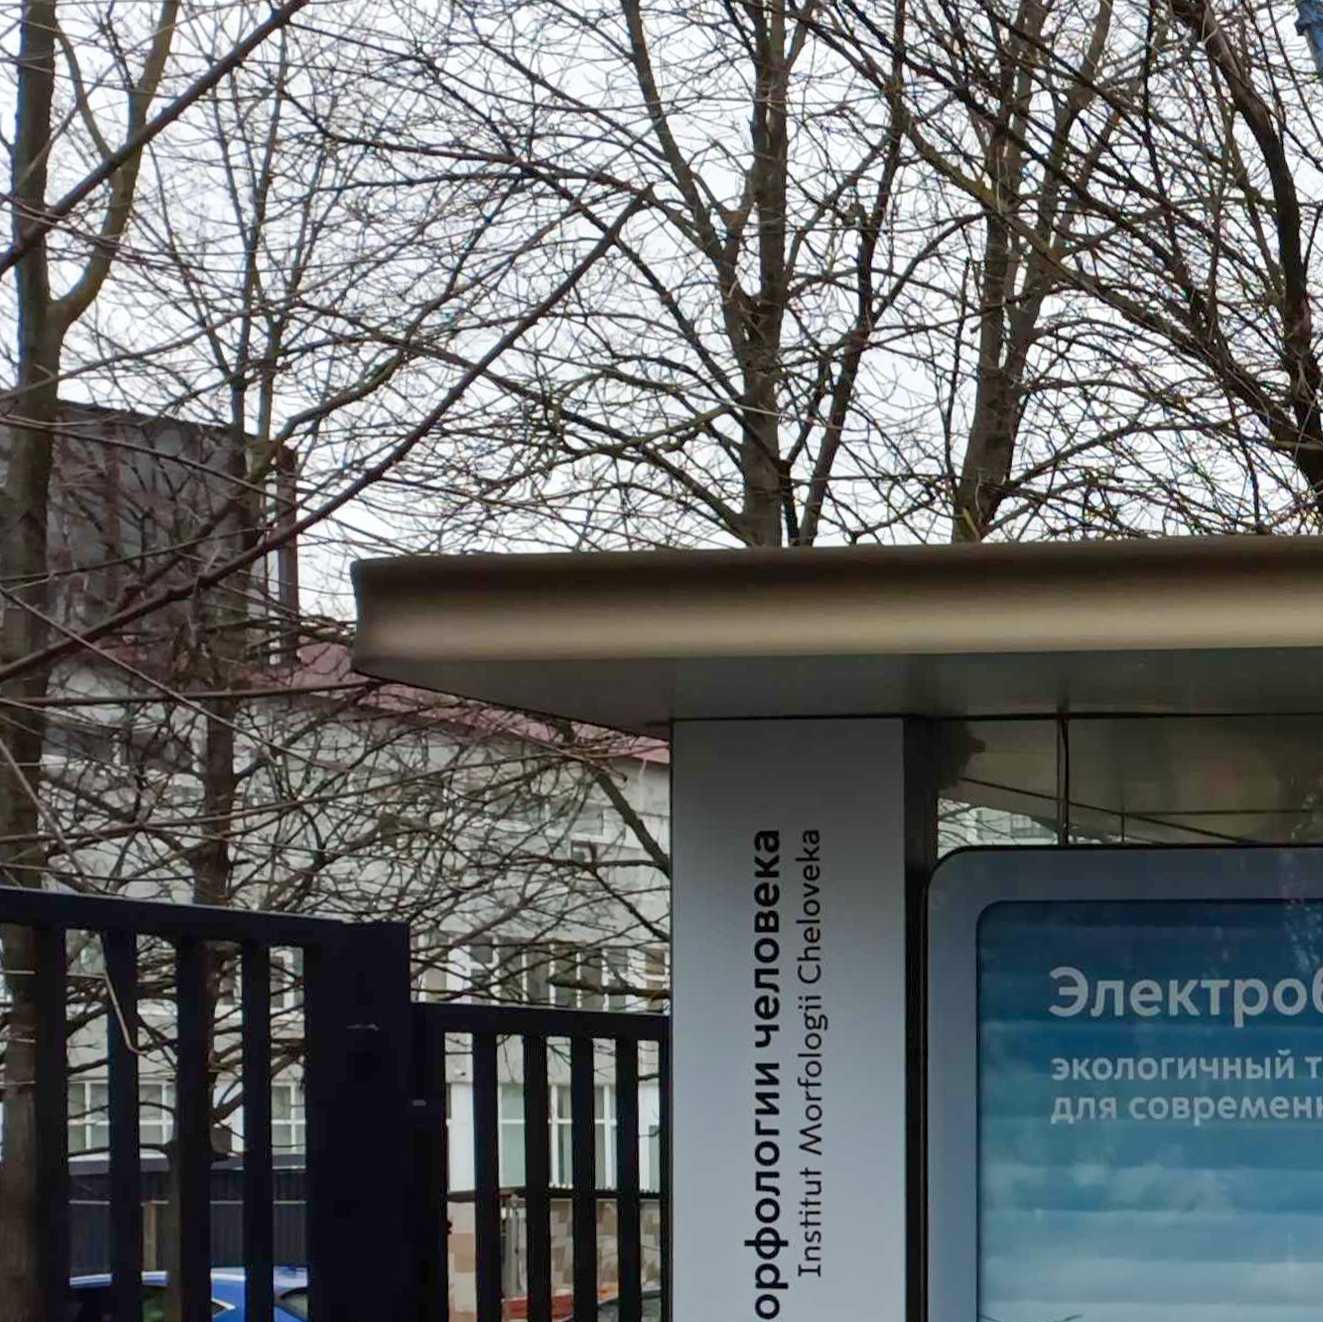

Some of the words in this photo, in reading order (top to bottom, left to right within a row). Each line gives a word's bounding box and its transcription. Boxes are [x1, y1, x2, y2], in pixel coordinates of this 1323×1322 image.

[753, 828, 781, 1049] человека
[796, 828, 822, 985] Cheloveka
[796, 995, 829, 1157] Morfologii
[1050, 1093, 1118, 1124] для
[1051, 1049, 1295, 1080] экологичный
[797, 1167, 823, 1278] Institut
